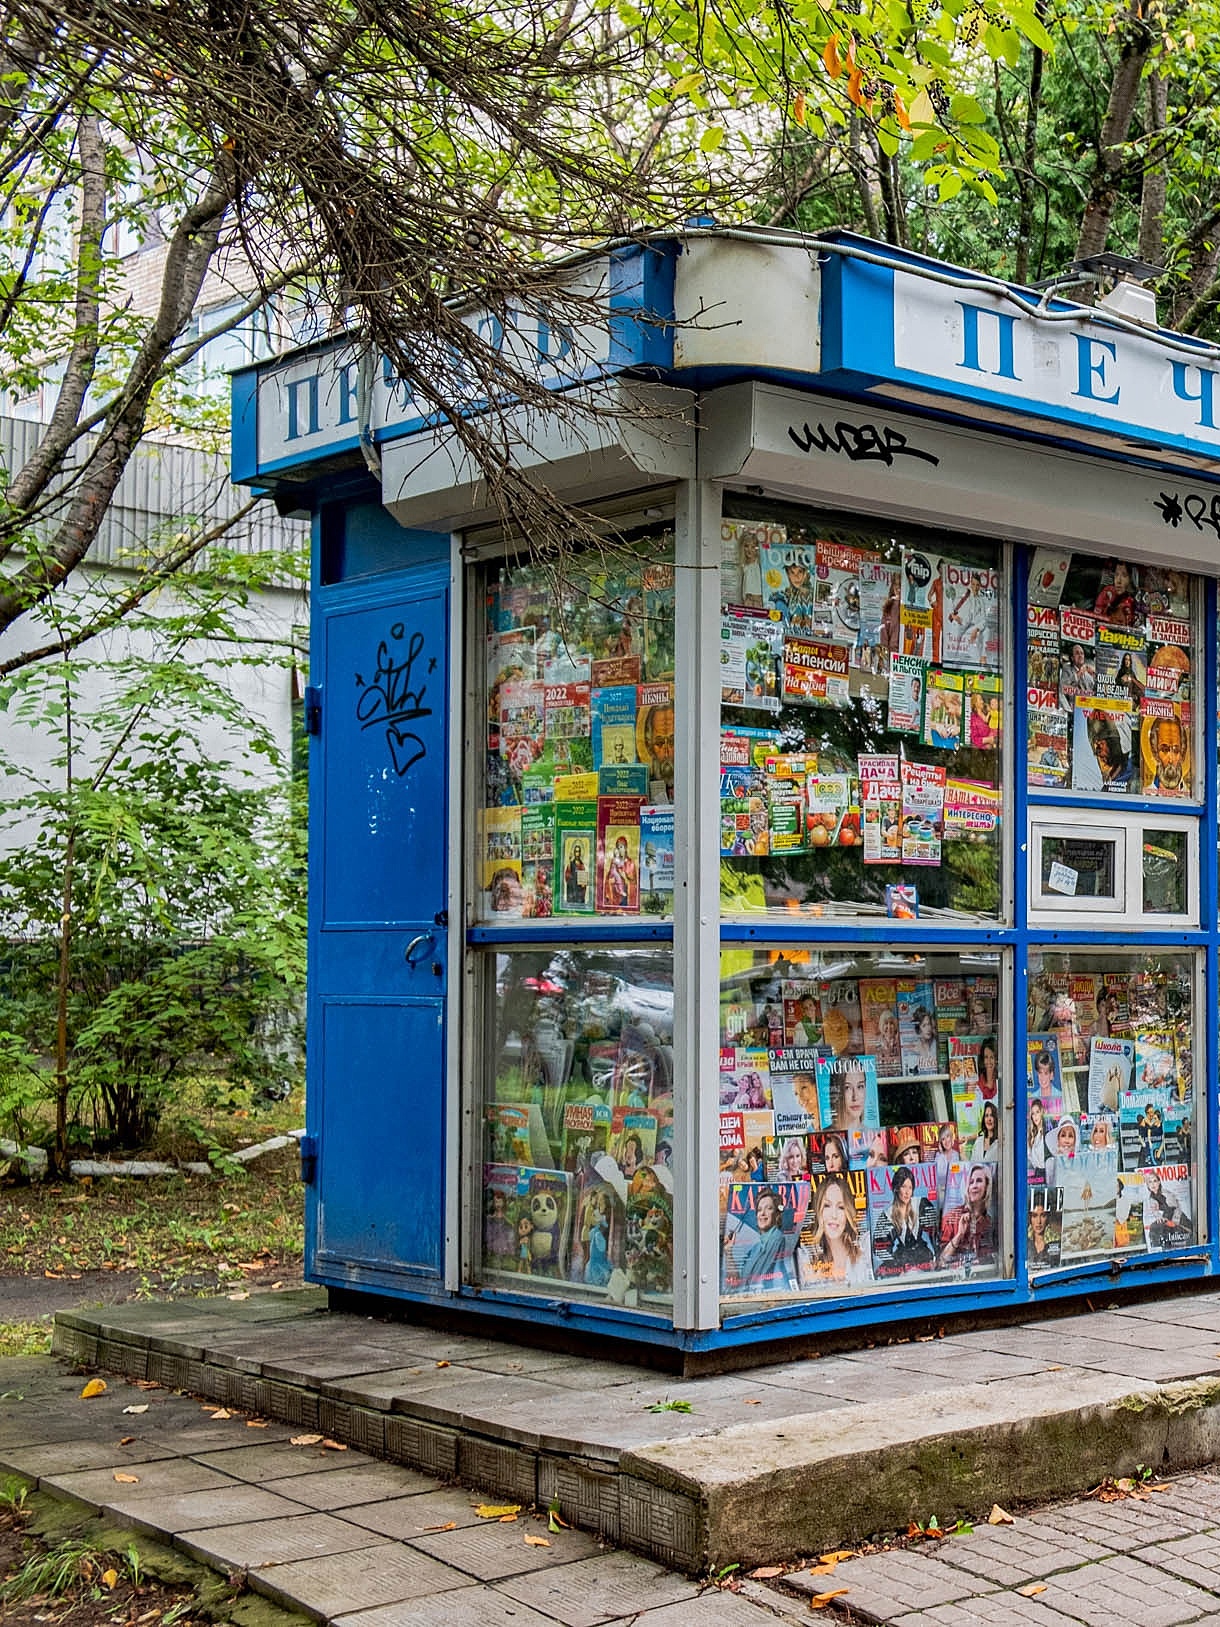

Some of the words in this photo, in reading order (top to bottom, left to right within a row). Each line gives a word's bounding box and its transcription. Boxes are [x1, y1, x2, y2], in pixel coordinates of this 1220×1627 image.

[817, 542, 862, 561] Вышивка
[1062, 623, 1094, 641] СССР
[1147, 675, 1178, 692] МИРА
[545, 688, 567, 700] 2022
[860, 768, 896, 779] ДАЧА
[867, 781, 901, 801] Дача
[770, 1060, 789, 1071] ВАМ
[789, 1060, 799, 1070] НЕ
[776, 1112, 803, 1123] Слышу
[777, 1121, 808, 1132] отлично!
[731, 1183, 809, 1213] КАВАН
[1030, 1187, 1064, 1212] LLE
